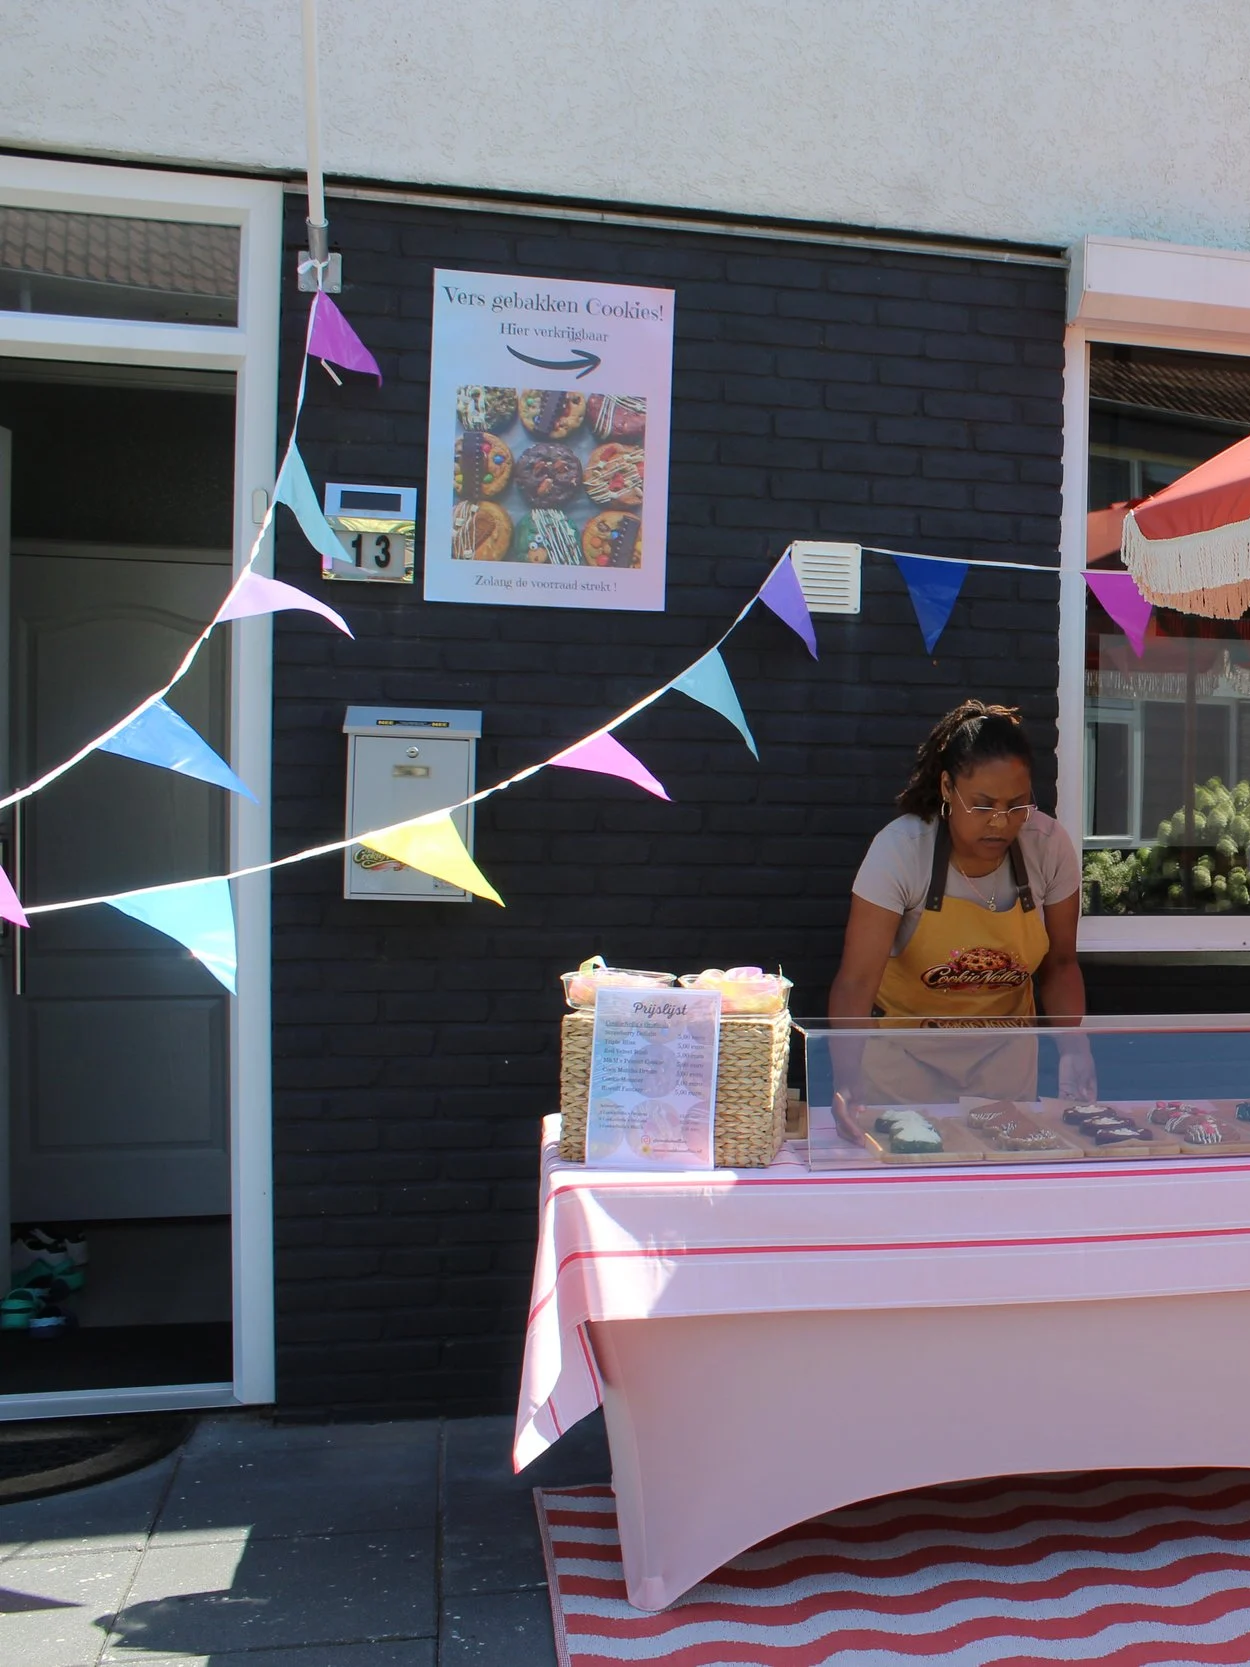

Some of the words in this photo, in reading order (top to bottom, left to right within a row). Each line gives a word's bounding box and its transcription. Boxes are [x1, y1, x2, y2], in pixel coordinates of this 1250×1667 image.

[442, 285, 486, 306] Vers
[491, 291, 578, 314] gebakken
[586, 297, 664, 321] Cookies!
[500, 322, 530, 337] Hier
[534, 325, 609, 343] verkrijgbaar
[351, 533, 392, 568] 13
[474, 575, 513, 589] Zolang
[516, 577, 528, 587] de
[532, 579, 578, 591] voorraad
[580, 581, 611, 592] strekt
[924, 965, 1030, 986] CookieNella's
[633, 1002, 688, 1019] Prijslijst
